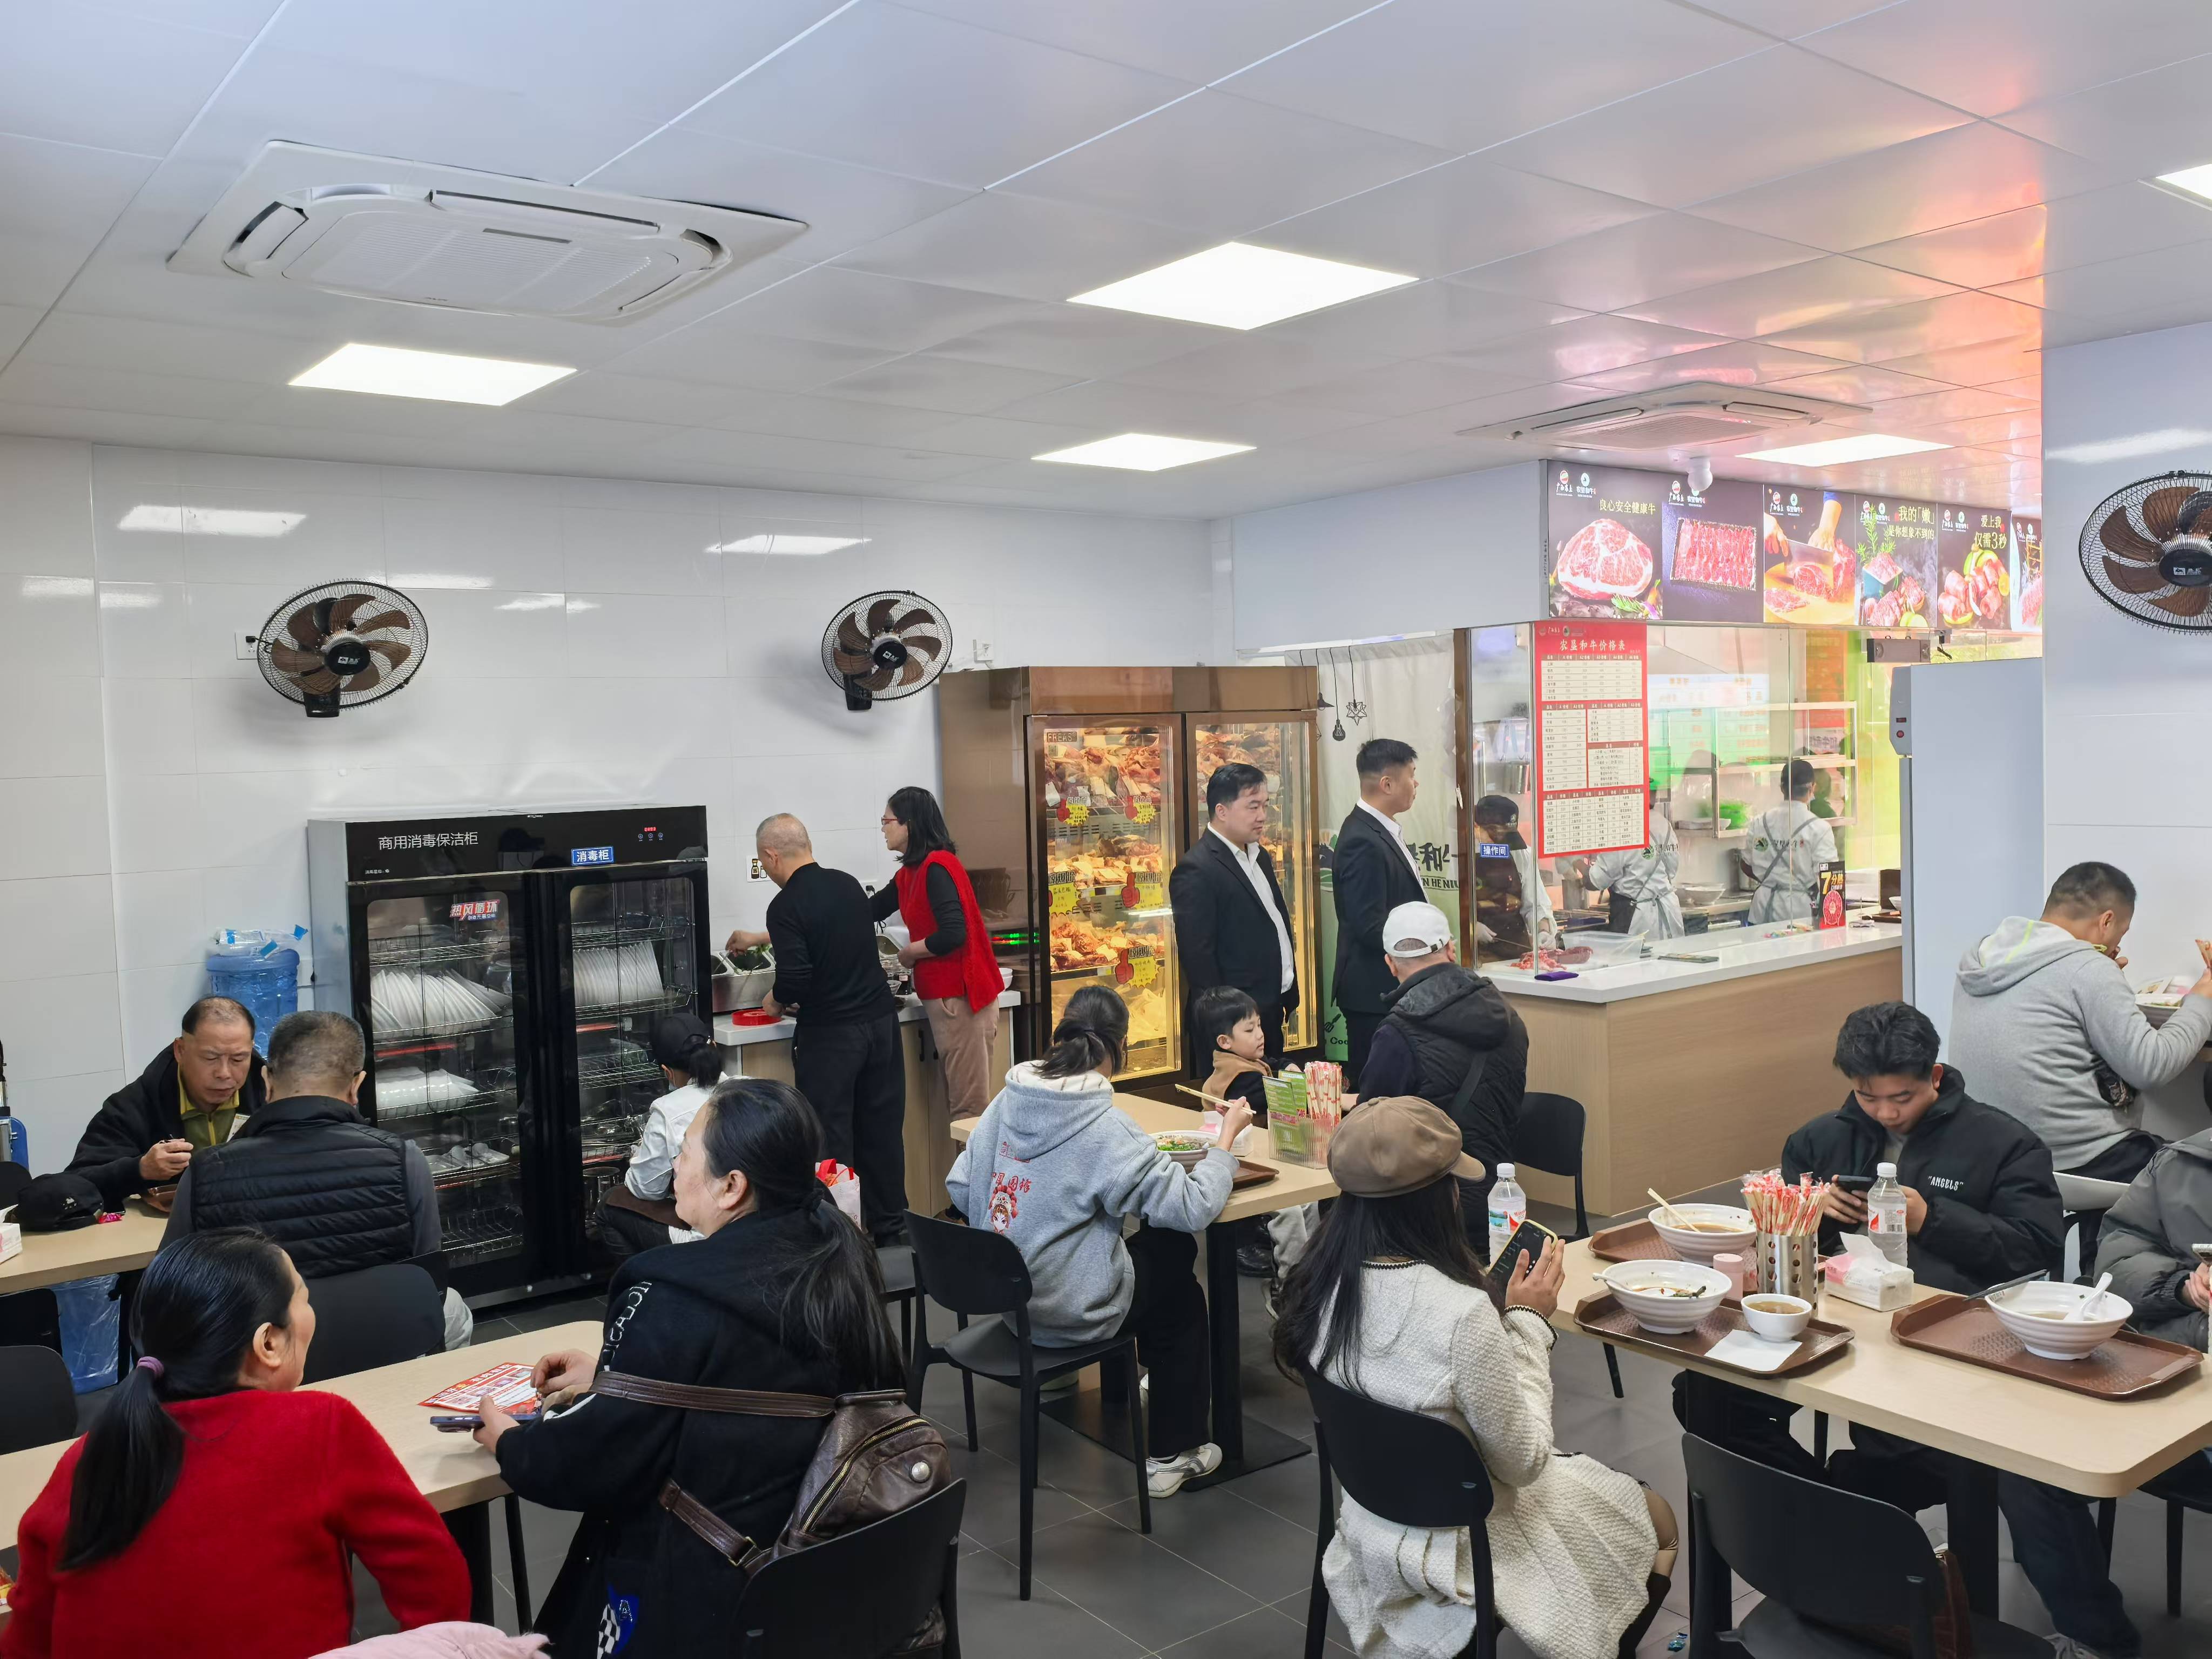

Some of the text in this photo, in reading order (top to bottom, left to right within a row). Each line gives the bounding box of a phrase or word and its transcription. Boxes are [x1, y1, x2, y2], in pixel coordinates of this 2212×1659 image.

[1599, 498, 1656, 515] 良心安全健康牛
[1980, 515, 2002, 529] 爱上我
[1889, 524, 1934, 540] 是你想象不到的
[1974, 531, 2007, 550] 仅需3秒
[1560, 639, 1626, 651] 农垦和牛价格表
[378, 832, 478, 851] 商用消毒保洁柜
[576, 849, 610, 862] 消毒柜
[1483, 845, 1506, 856] 操作间
[1431, 878, 1442, 888] HE
[449, 900, 498, 920] 热风循环
